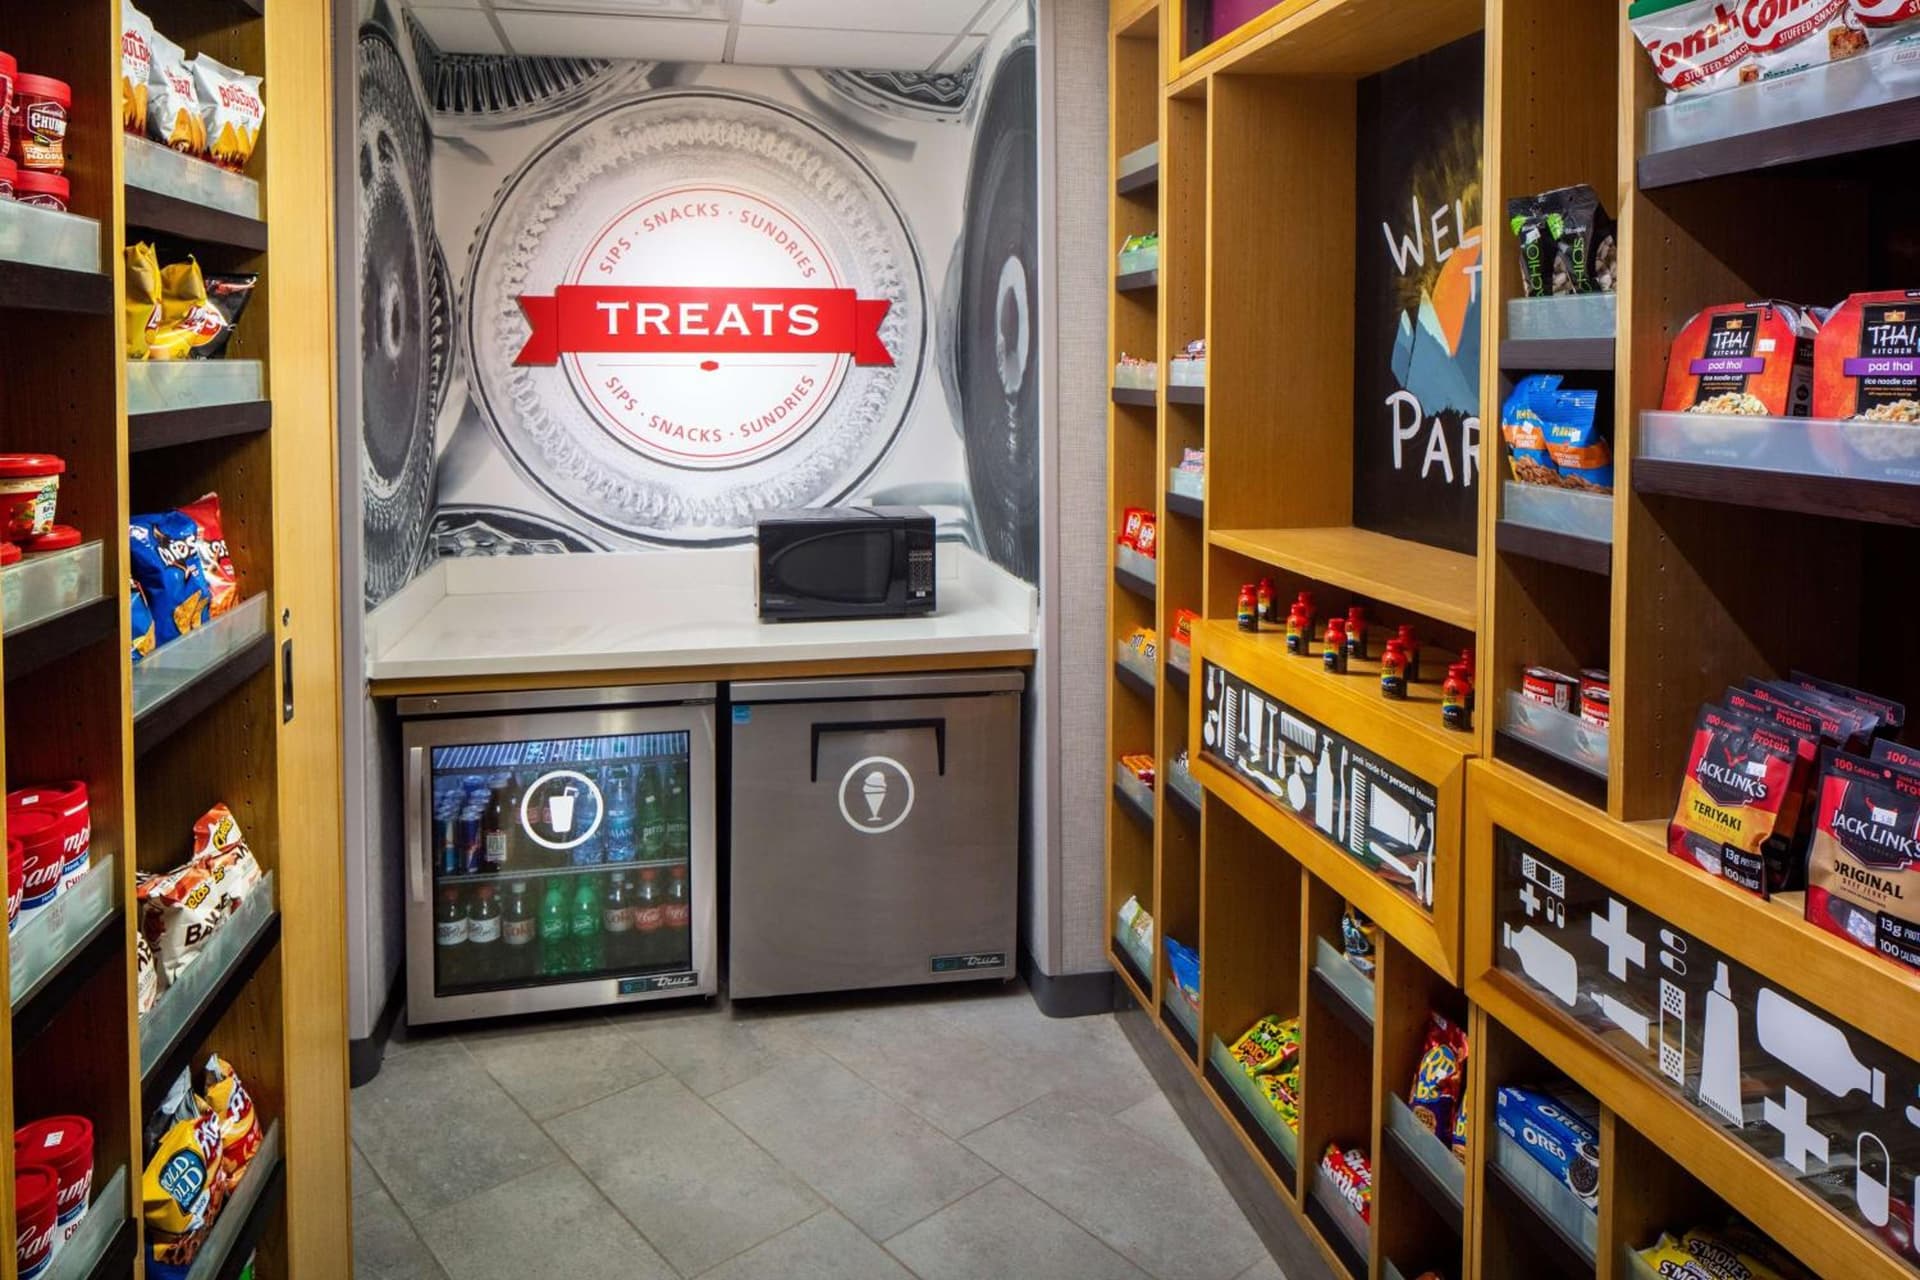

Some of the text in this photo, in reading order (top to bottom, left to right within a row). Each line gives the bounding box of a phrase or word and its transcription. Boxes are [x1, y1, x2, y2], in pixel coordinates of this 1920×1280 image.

[1645, 3, 1741, 70] Comb
[1779, 20, 1813, 44] STUFFED
[1683, 43, 1750, 83] STUFFED SNAC
[599, 203, 817, 279] SIPS SNACKS SUNDRIES
[1382, 194, 1481, 276] WEL
[1463, 264, 1482, 304] T
[596, 300, 821, 337] TREATS
[1712, 331, 1751, 350] THAI
[1867, 324, 1918, 347] THAI
[1713, 349, 1745, 357] KITCHEN
[1872, 347, 1913, 355] KITCHEN
[1708, 360, 1743, 371] pad thai
[1868, 360, 1913, 373] pad thai
[605, 374, 816, 443] SIPS SNACKS SUNDRIES
[1384, 390, 1481, 488] PAR
[1731, 695, 1746, 706] 100
[1706, 713, 1721, 726] 100
[1776, 712, 1813, 732] Protein
[1752, 732, 1790, 755] Protein
[1834, 758, 1853, 772] 100
[1888, 751, 1907, 765] 100
[1696, 756, 1767, 799] JACK LINK'S
[1896, 779, 1920, 797] Prot
[1693, 799, 1742, 832] TERIYAKI
[1832, 809, 1867, 841] JACK
[1725, 847, 1740, 866] 13g
[1724, 865, 1739, 882] 100
[1881, 916, 1920, 943] 13g PROT
[1879, 938, 1899, 957] 100
[1537, 1104, 1593, 1141] OREO
[1522, 1127, 1567, 1161] OREO
[173, 1165, 205, 1200] OLD
[1321, 1155, 1365, 1213] Skittles
[1660, 1261, 1702, 1280] S'MO
[1689, 1239, 1749, 1280] S'MORES
[1698, 1256, 1732, 1280] TREATS
